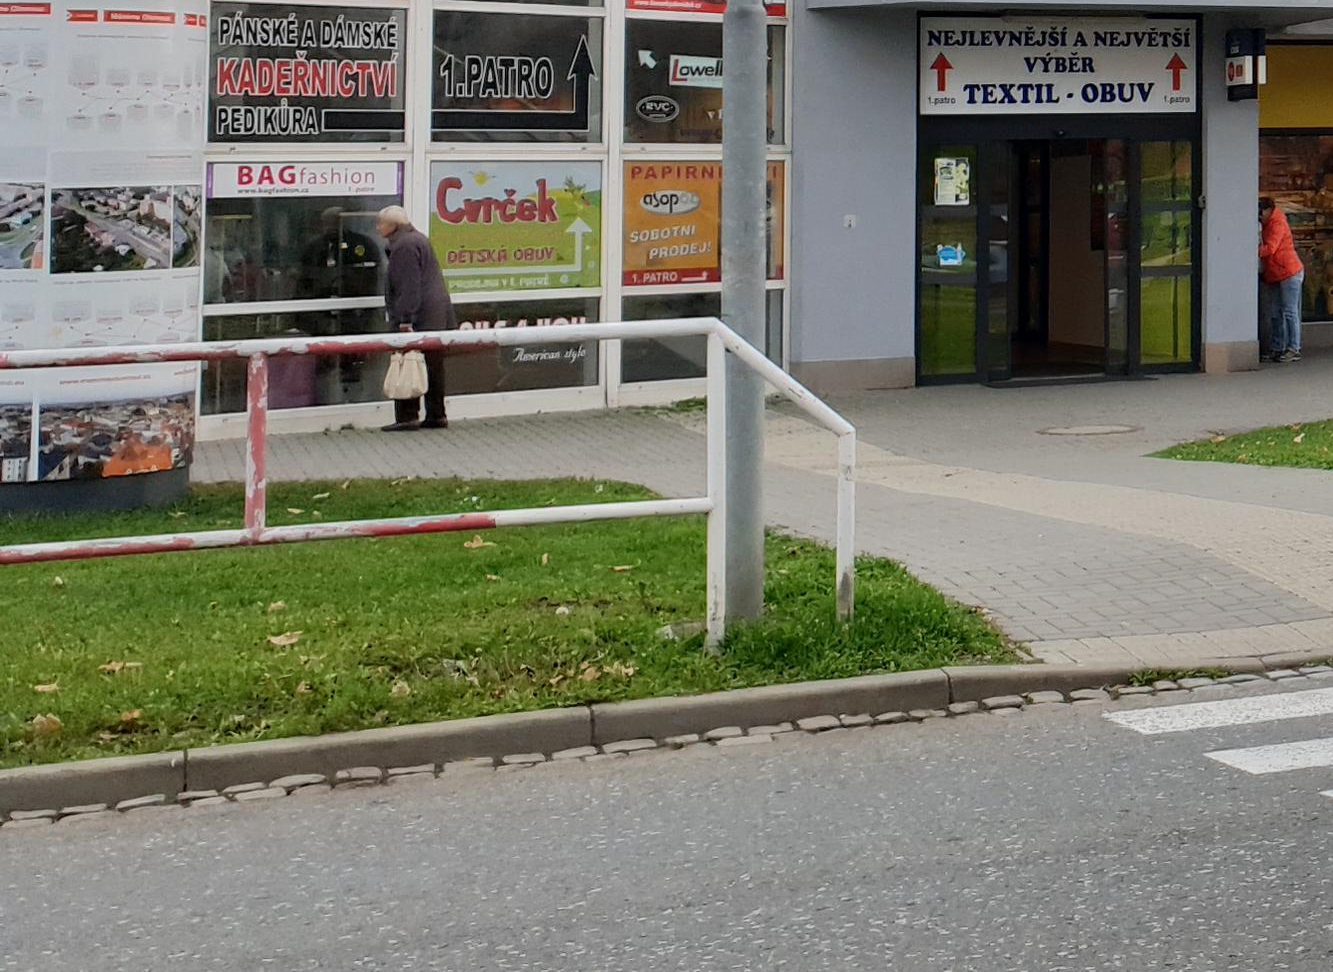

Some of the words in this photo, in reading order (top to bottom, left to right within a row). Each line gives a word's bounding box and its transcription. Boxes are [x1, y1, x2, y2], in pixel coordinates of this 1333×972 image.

[218, 11, 298, 46] PÁNSKÉ
[301, 19, 317, 47] A
[320, 15, 398, 50] DÁMSKÉ
[927, 26, 1067, 48] NEJLEVNĚJŠÍ
[1073, 30, 1088, 47] A
[1093, 27, 1191, 48] NEJVĚTŠÍ
[217, 50, 398, 98] KADEŘNICTVÍ
[1024, 52, 1095, 74] VÝBĚR
[440, 54, 554, 99] 1.PATRO
[963, 82, 1060, 104] TEXTIL
[1081, 82, 1155, 104] OBUV
[216, 98, 320, 135] PEDIKŮRA
[436, 177, 560, 225] Cvrček
[447, 245, 508, 265] DĚTSKÁ
[514, 246, 555, 262] OBUV
[649, 241, 713, 259] PRODEJ!
[643, 271, 679, 283] PATRO
